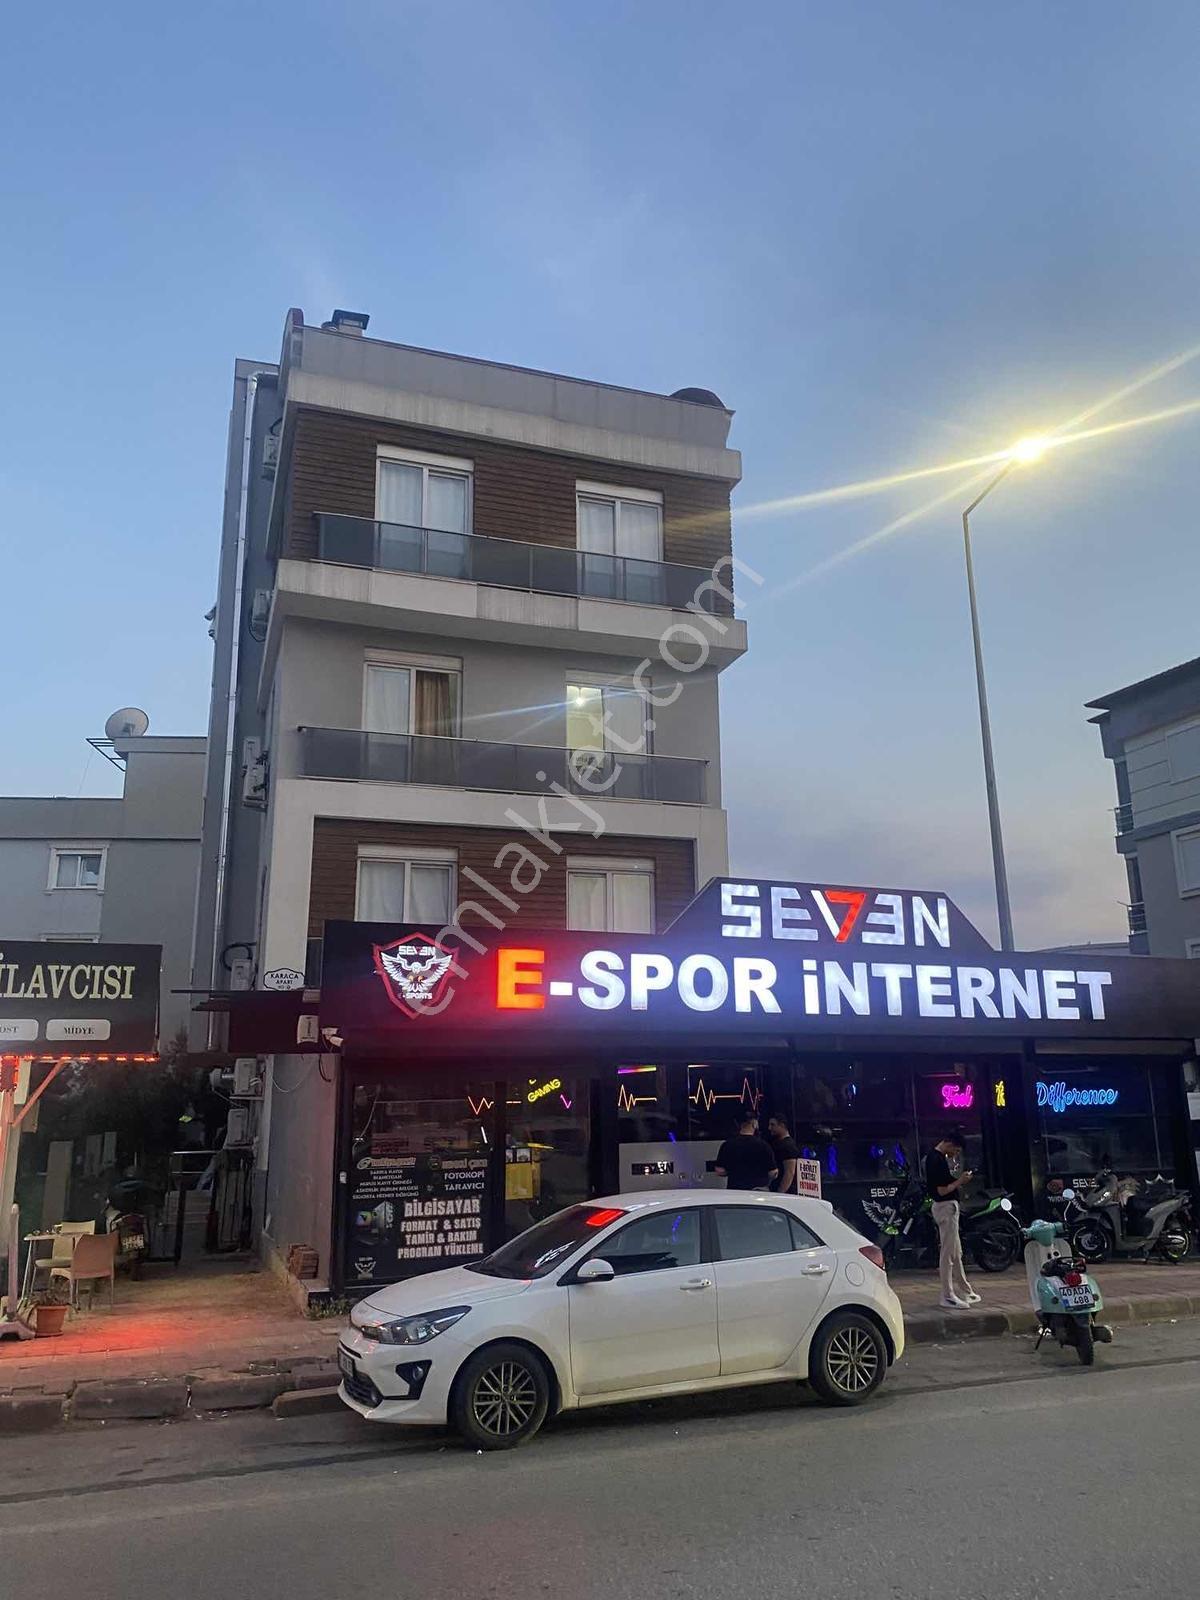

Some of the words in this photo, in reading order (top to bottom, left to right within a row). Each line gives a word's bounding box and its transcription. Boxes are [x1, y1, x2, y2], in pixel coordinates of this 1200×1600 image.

[497, 948, 782, 1013] E-SPOR
[528, 1079, 561, 1102] GAMING
[1036, 1082, 1118, 1113] Difference
[444, 1169, 485, 1180] FOTOKOPİ
[404, 1198, 481, 1217] BİLGİSAYAR
[401, 1219, 438, 1232] FORMAT
[443, 1219, 452, 1230] &
[454, 1217, 481, 1230] SATIŞ
[405, 1231, 435, 1245] TAMİR
[437, 1233, 445, 1243] &
[448, 1230, 477, 1243] BAKIM
[398, 1245, 442, 1259] PROGRAM
[444, 1243, 483, 1256] YÜKLEME
